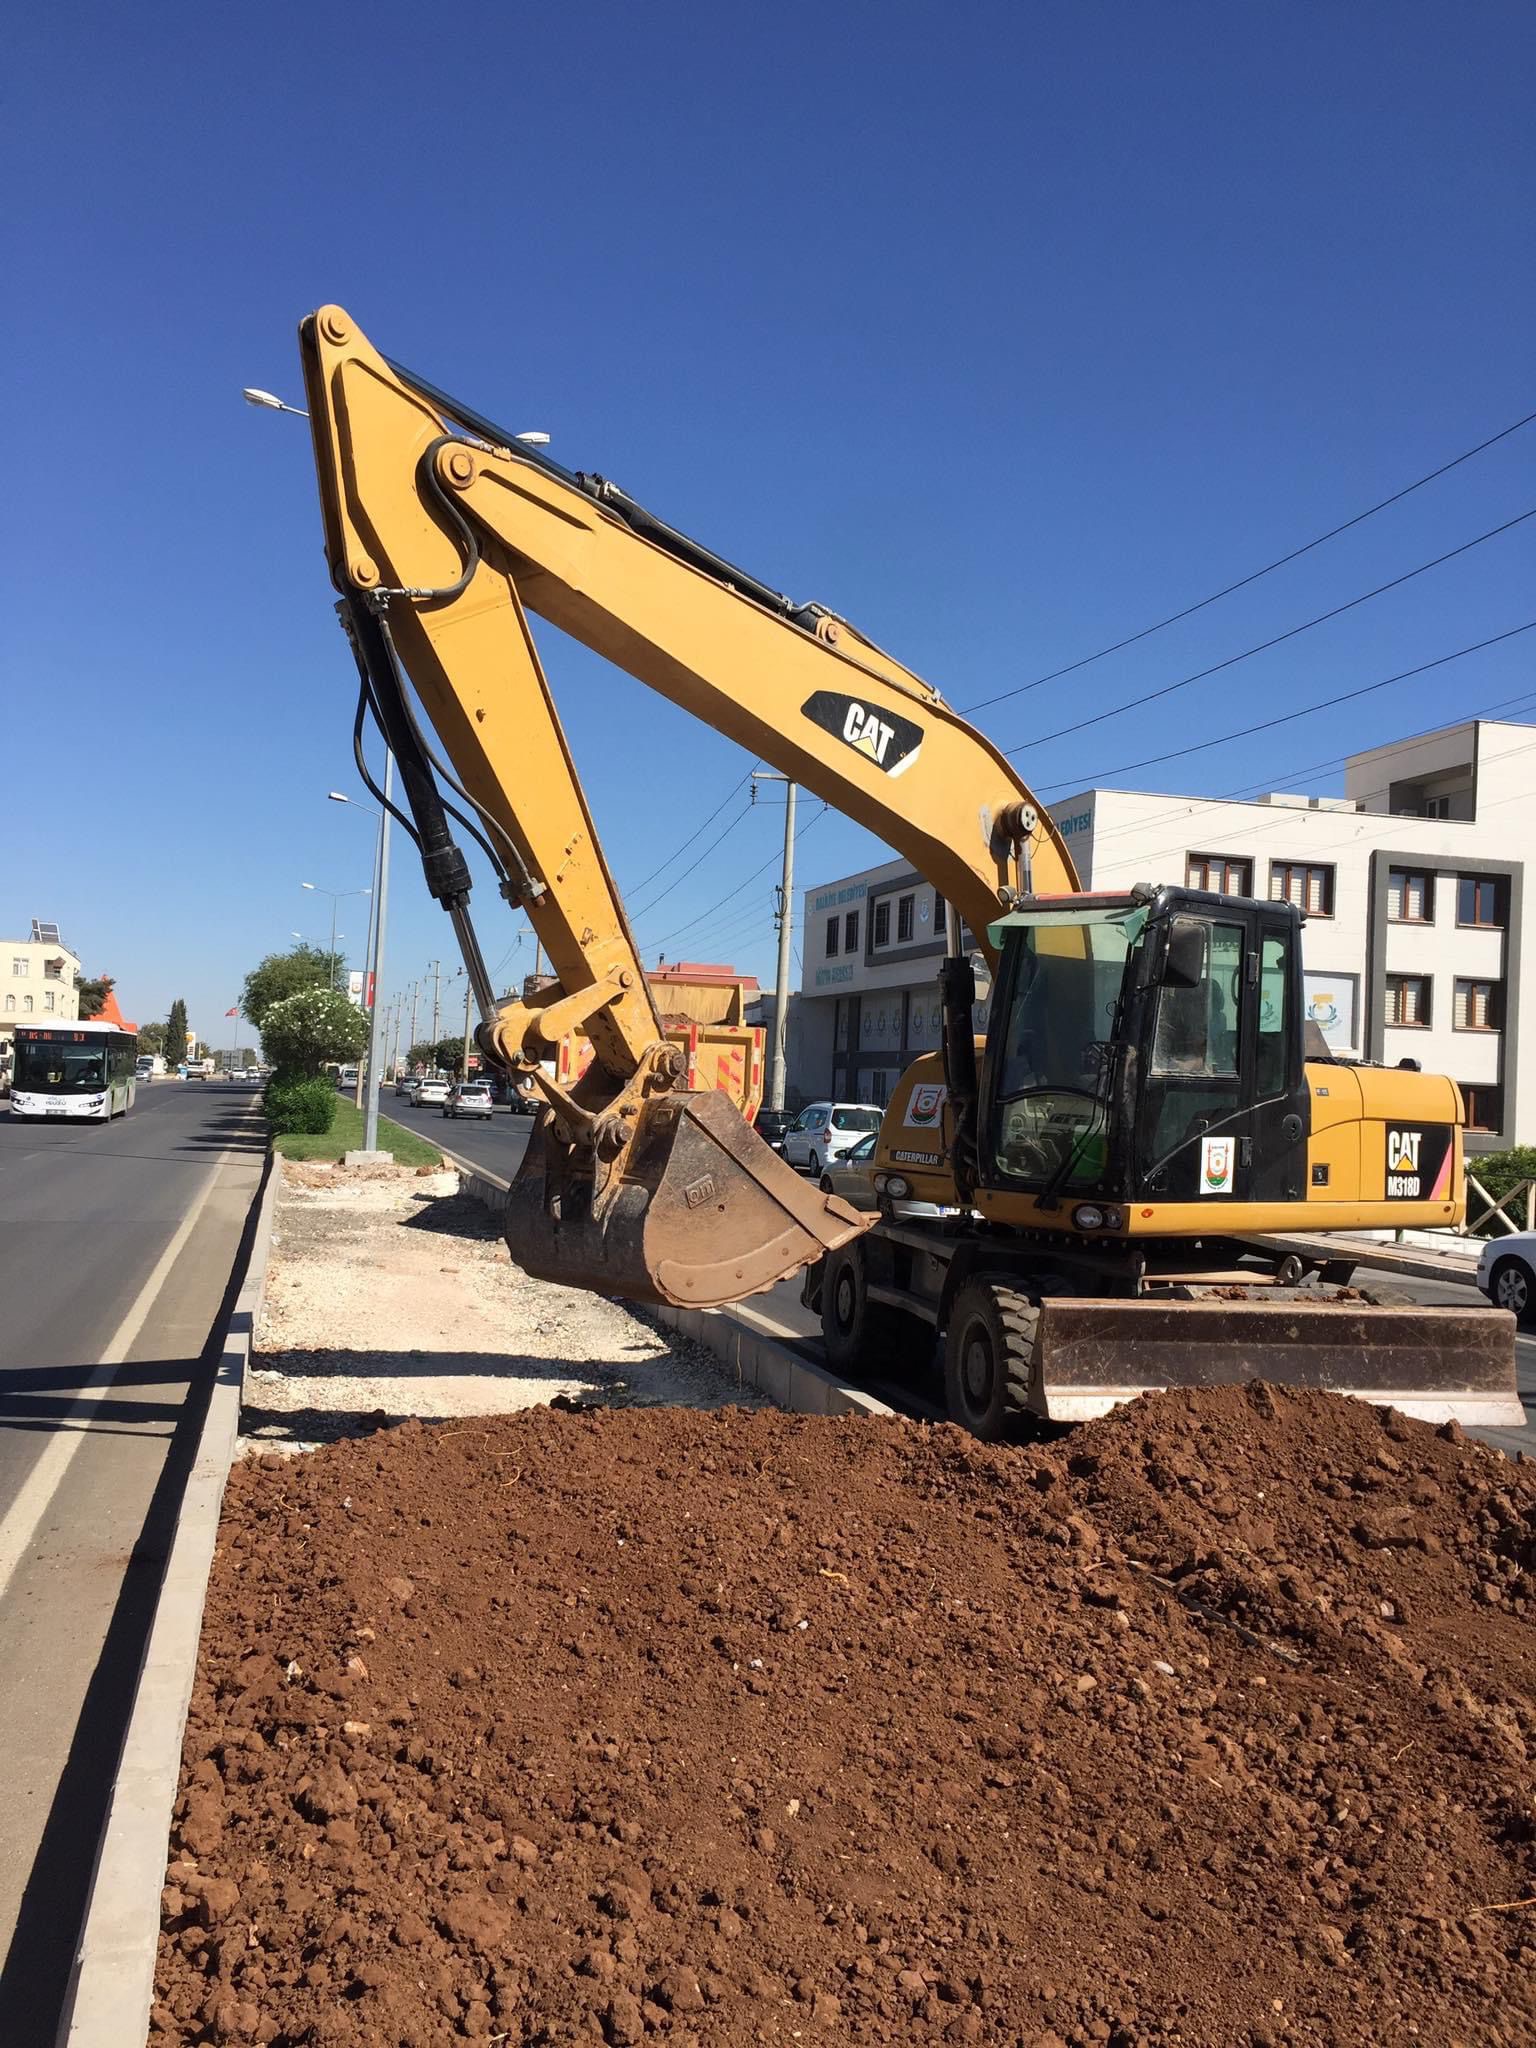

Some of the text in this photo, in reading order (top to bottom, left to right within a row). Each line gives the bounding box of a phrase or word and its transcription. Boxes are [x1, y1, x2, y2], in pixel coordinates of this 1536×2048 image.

[843, 702, 895, 765] CAT
[895, 1150, 938, 1164] CATERPILLAR
[1388, 1130, 1422, 1171] CAT
[1387, 1176, 1420, 1197] M318D
